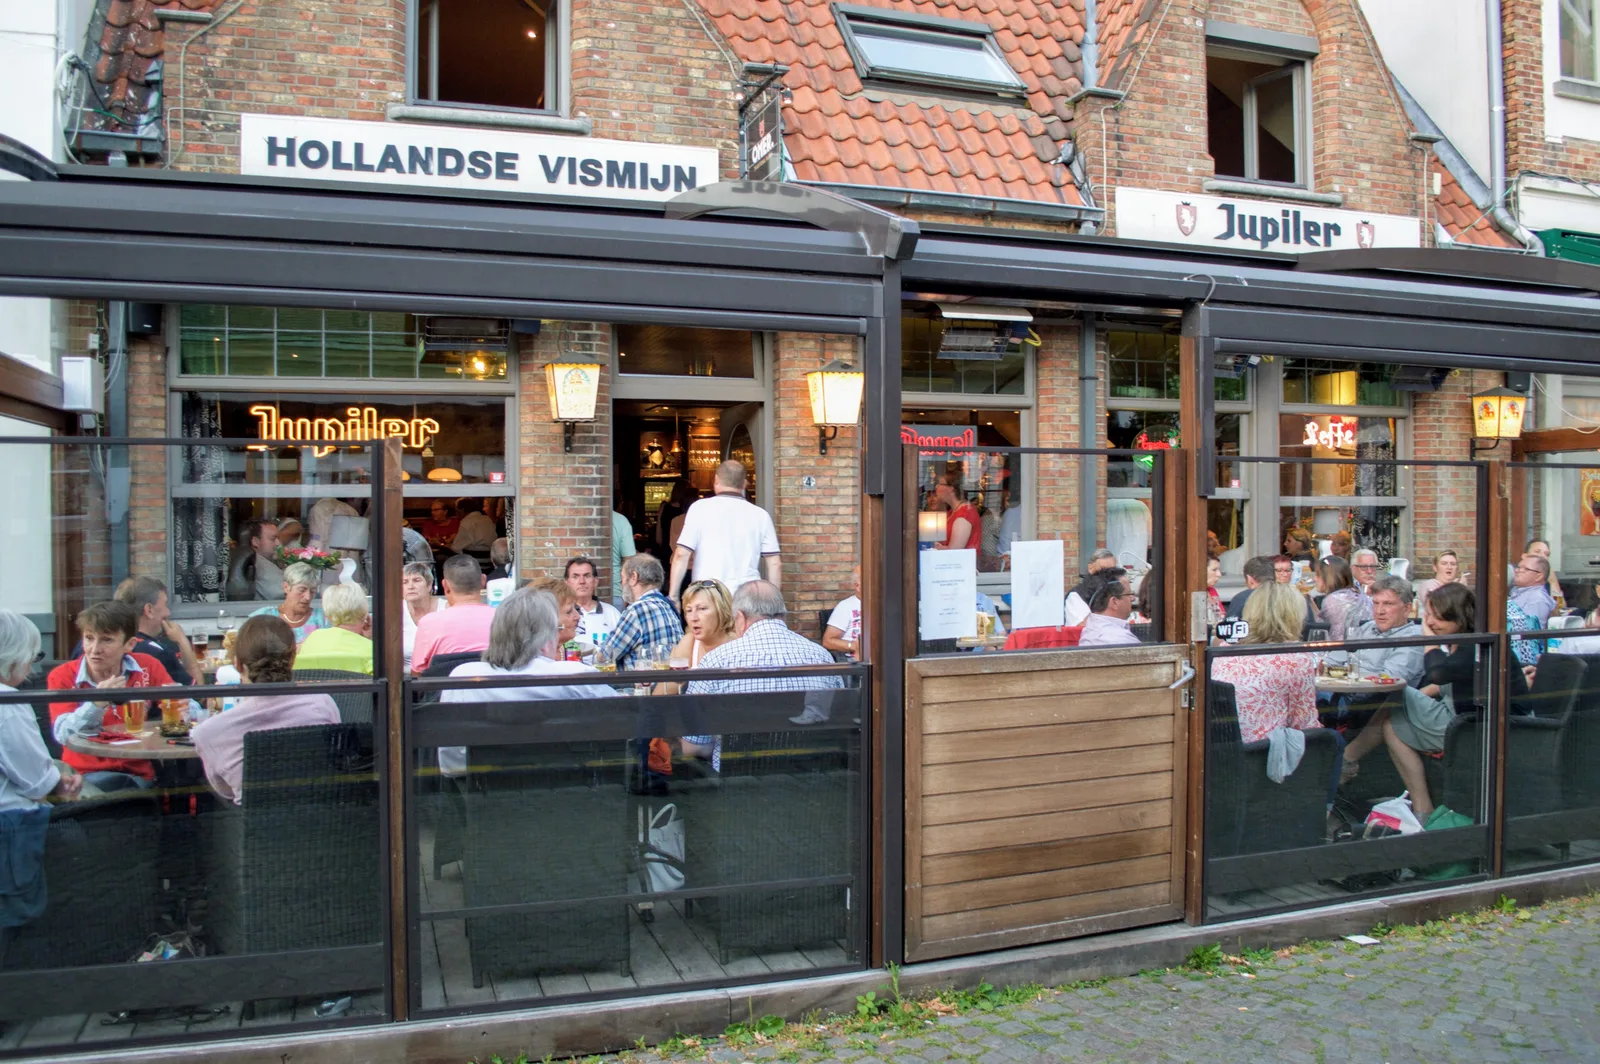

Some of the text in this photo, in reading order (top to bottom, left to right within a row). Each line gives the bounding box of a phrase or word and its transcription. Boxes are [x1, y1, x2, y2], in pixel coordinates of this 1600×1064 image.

[266, 135, 519, 181] HOLLANDSE
[537, 154, 697, 193] VISMIJN
[1214, 203, 1341, 249] Jupiler
[247, 405, 440, 458] Jupiler
[1302, 420, 1354, 449] Leffe
[1217, 624, 1247, 637] WiFi
